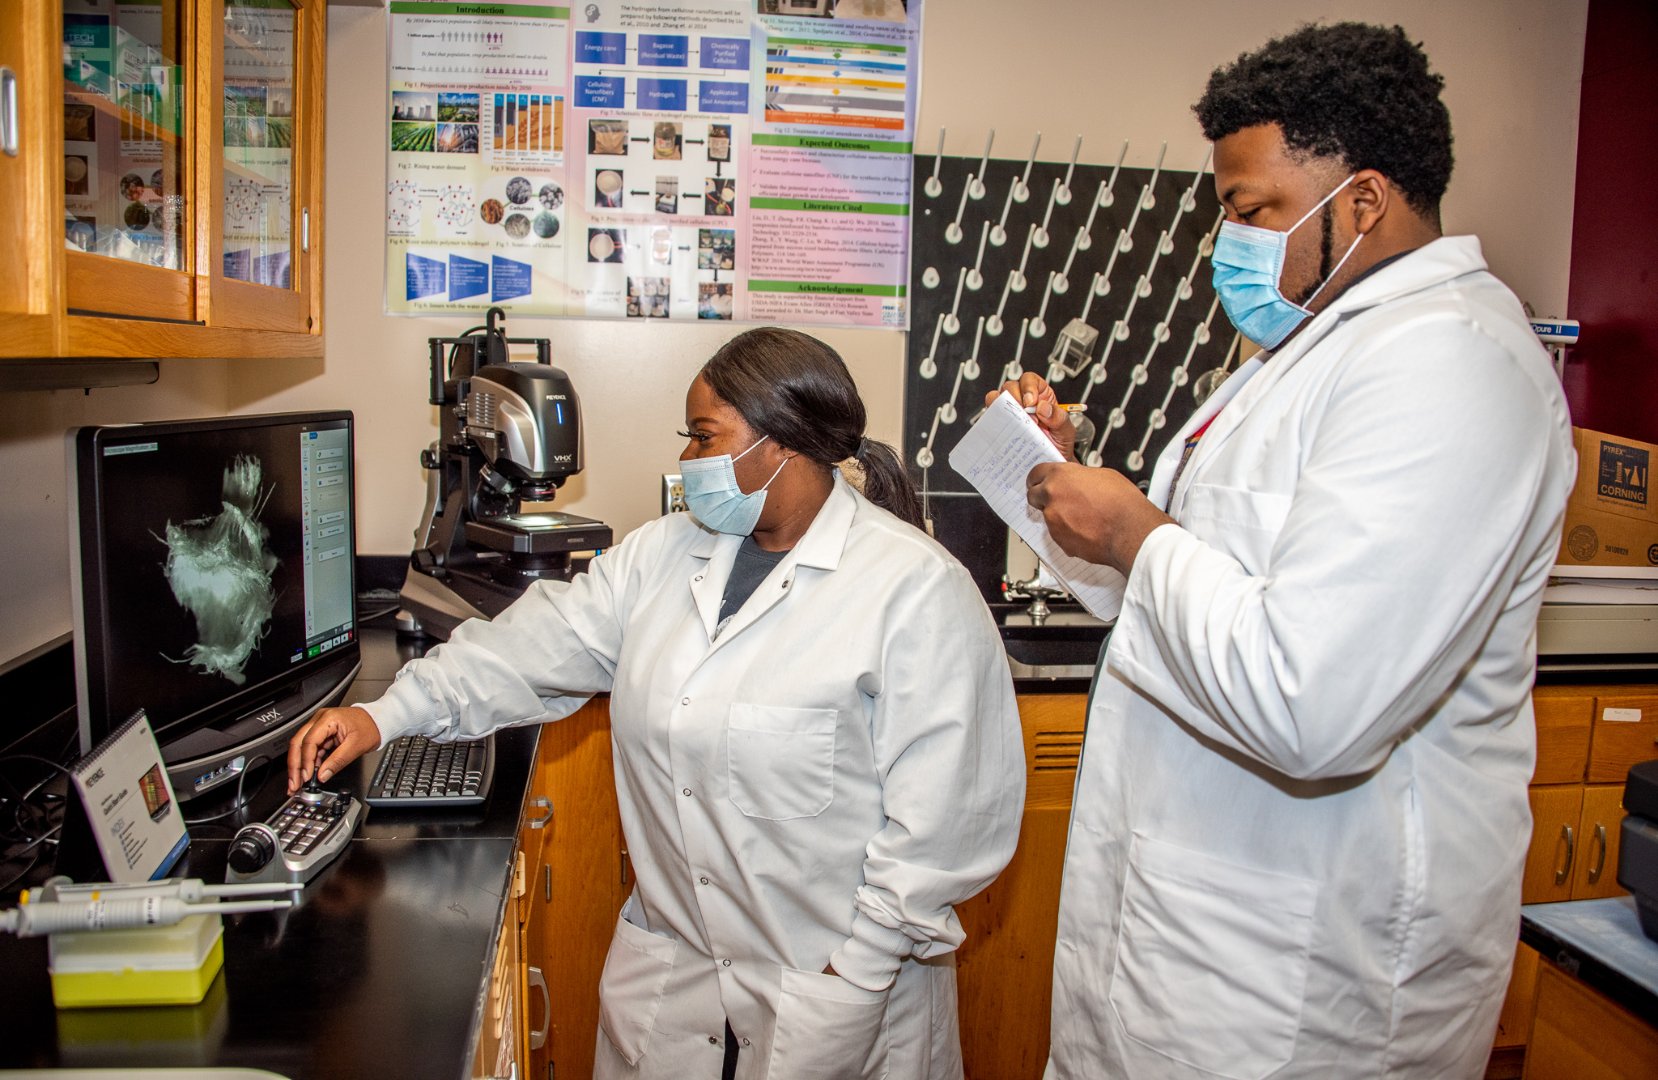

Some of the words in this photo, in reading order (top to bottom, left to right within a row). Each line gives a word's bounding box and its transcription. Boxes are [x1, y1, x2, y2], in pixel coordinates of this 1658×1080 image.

[456, 5, 505, 15] Introduction
[584, 44, 603, 53] Energy
[710, 43, 740, 51] Chemically
[420, 82, 448, 90] Projections
[468, 83, 495, 91] production
[584, 88, 615, 96] Nanofibers
[648, 91, 676, 99] Hydrogels
[709, 89, 739, 97] Application
[591, 96, 607, 104] (CNF)
[799, 138, 833, 148] Expected
[834, 141, 870, 150] Outcomes
[414, 163, 430, 171] Rising
[803, 202, 840, 212] Literature
[841, 204, 863, 213] Cited
[797, 284, 864, 294] Acknowledgement
[1603, 445, 1624, 456] PYREX
[1600, 484, 1645, 502] CORNING
[256, 708, 281, 722] VHX
